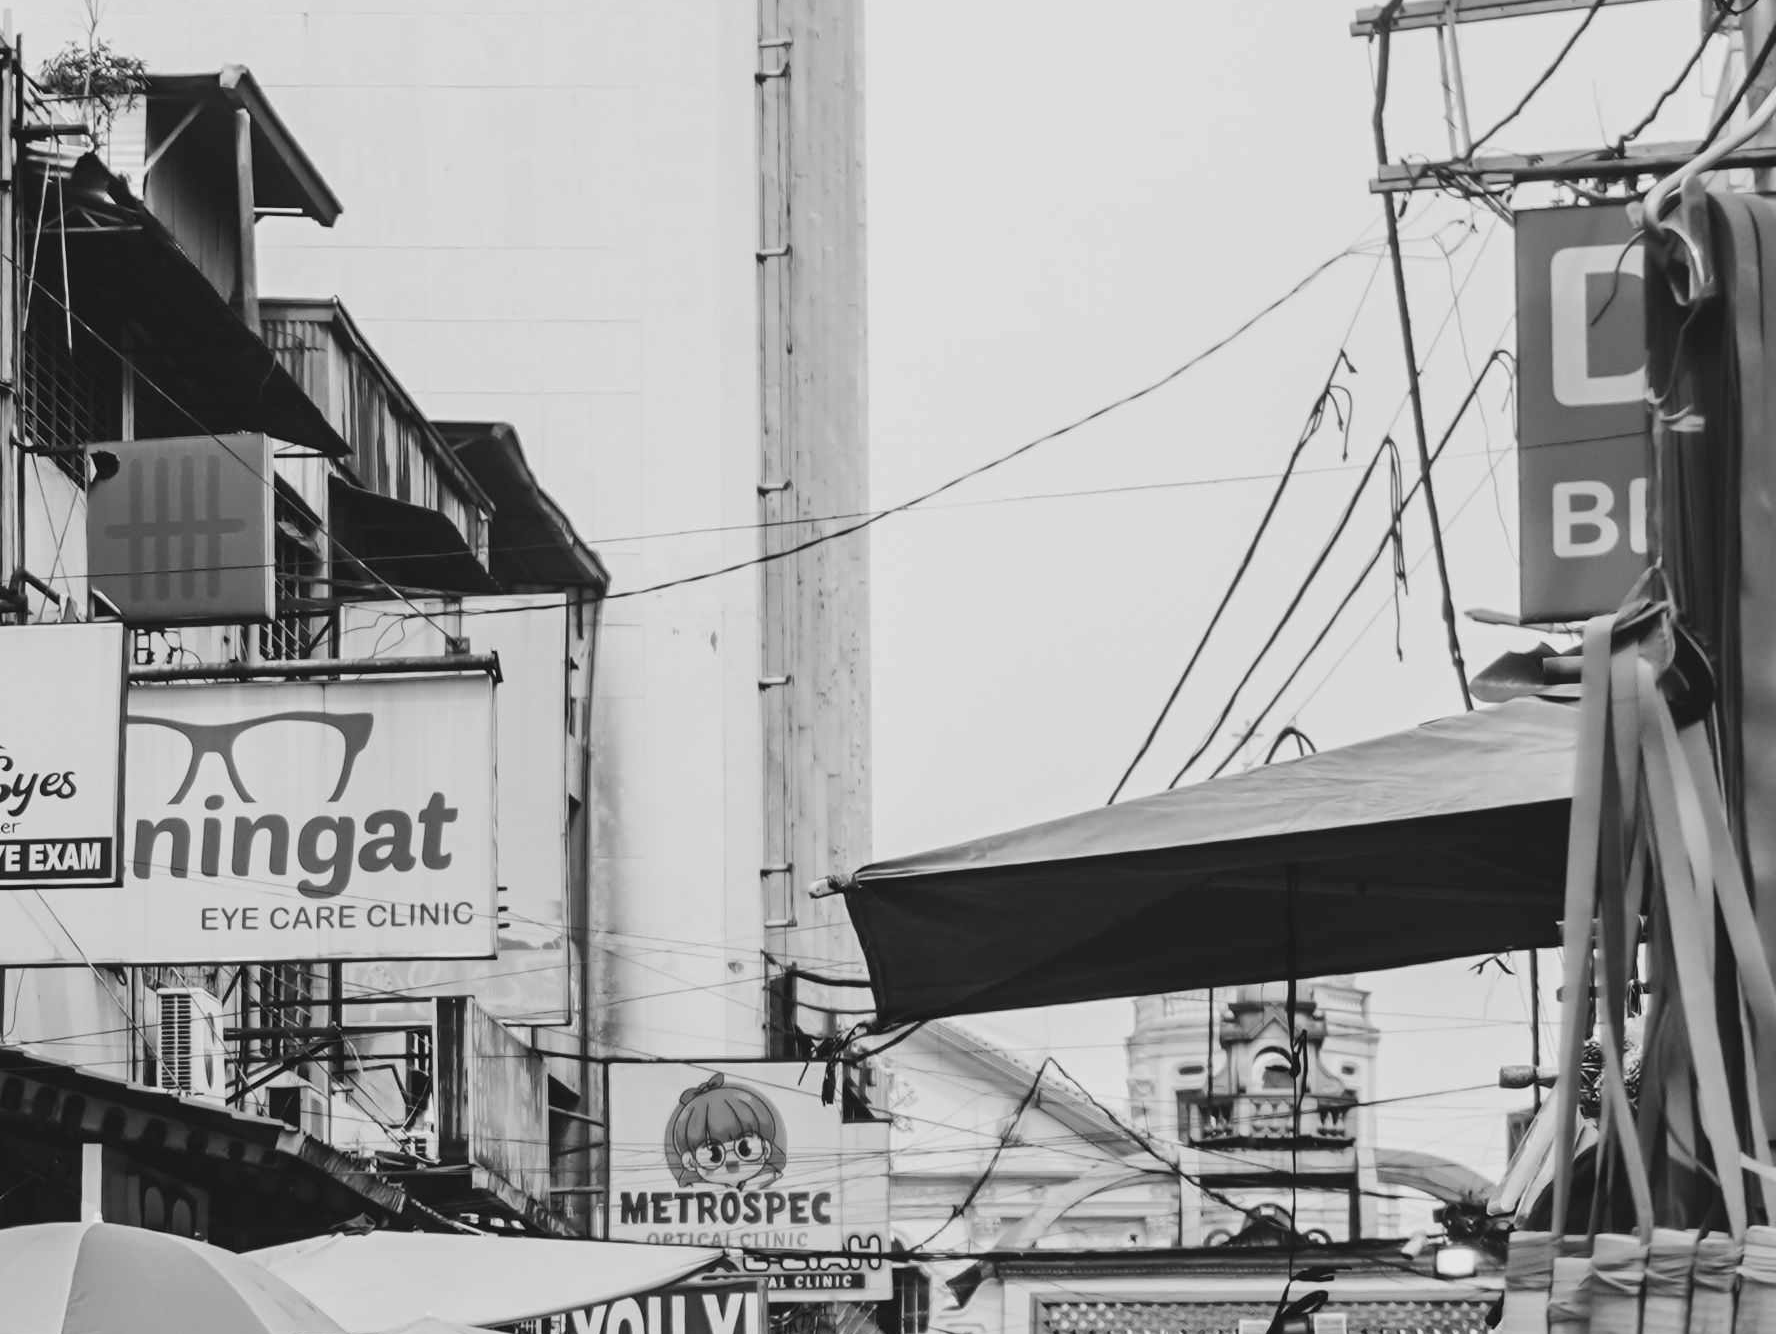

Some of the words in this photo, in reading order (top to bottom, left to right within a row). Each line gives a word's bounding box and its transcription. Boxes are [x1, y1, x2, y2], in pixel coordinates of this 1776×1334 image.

[28, 842, 102, 872] EXAM
[132, 791, 459, 900] ningat
[201, 907, 260, 930] EYE
[269, 905, 357, 930] CARE
[366, 901, 474, 927] CLINIC
[619, 1191, 832, 1225] METROSPEC
[742, 1231, 808, 1248] CLINIC
[794, 1275, 853, 1289] CLINIC
